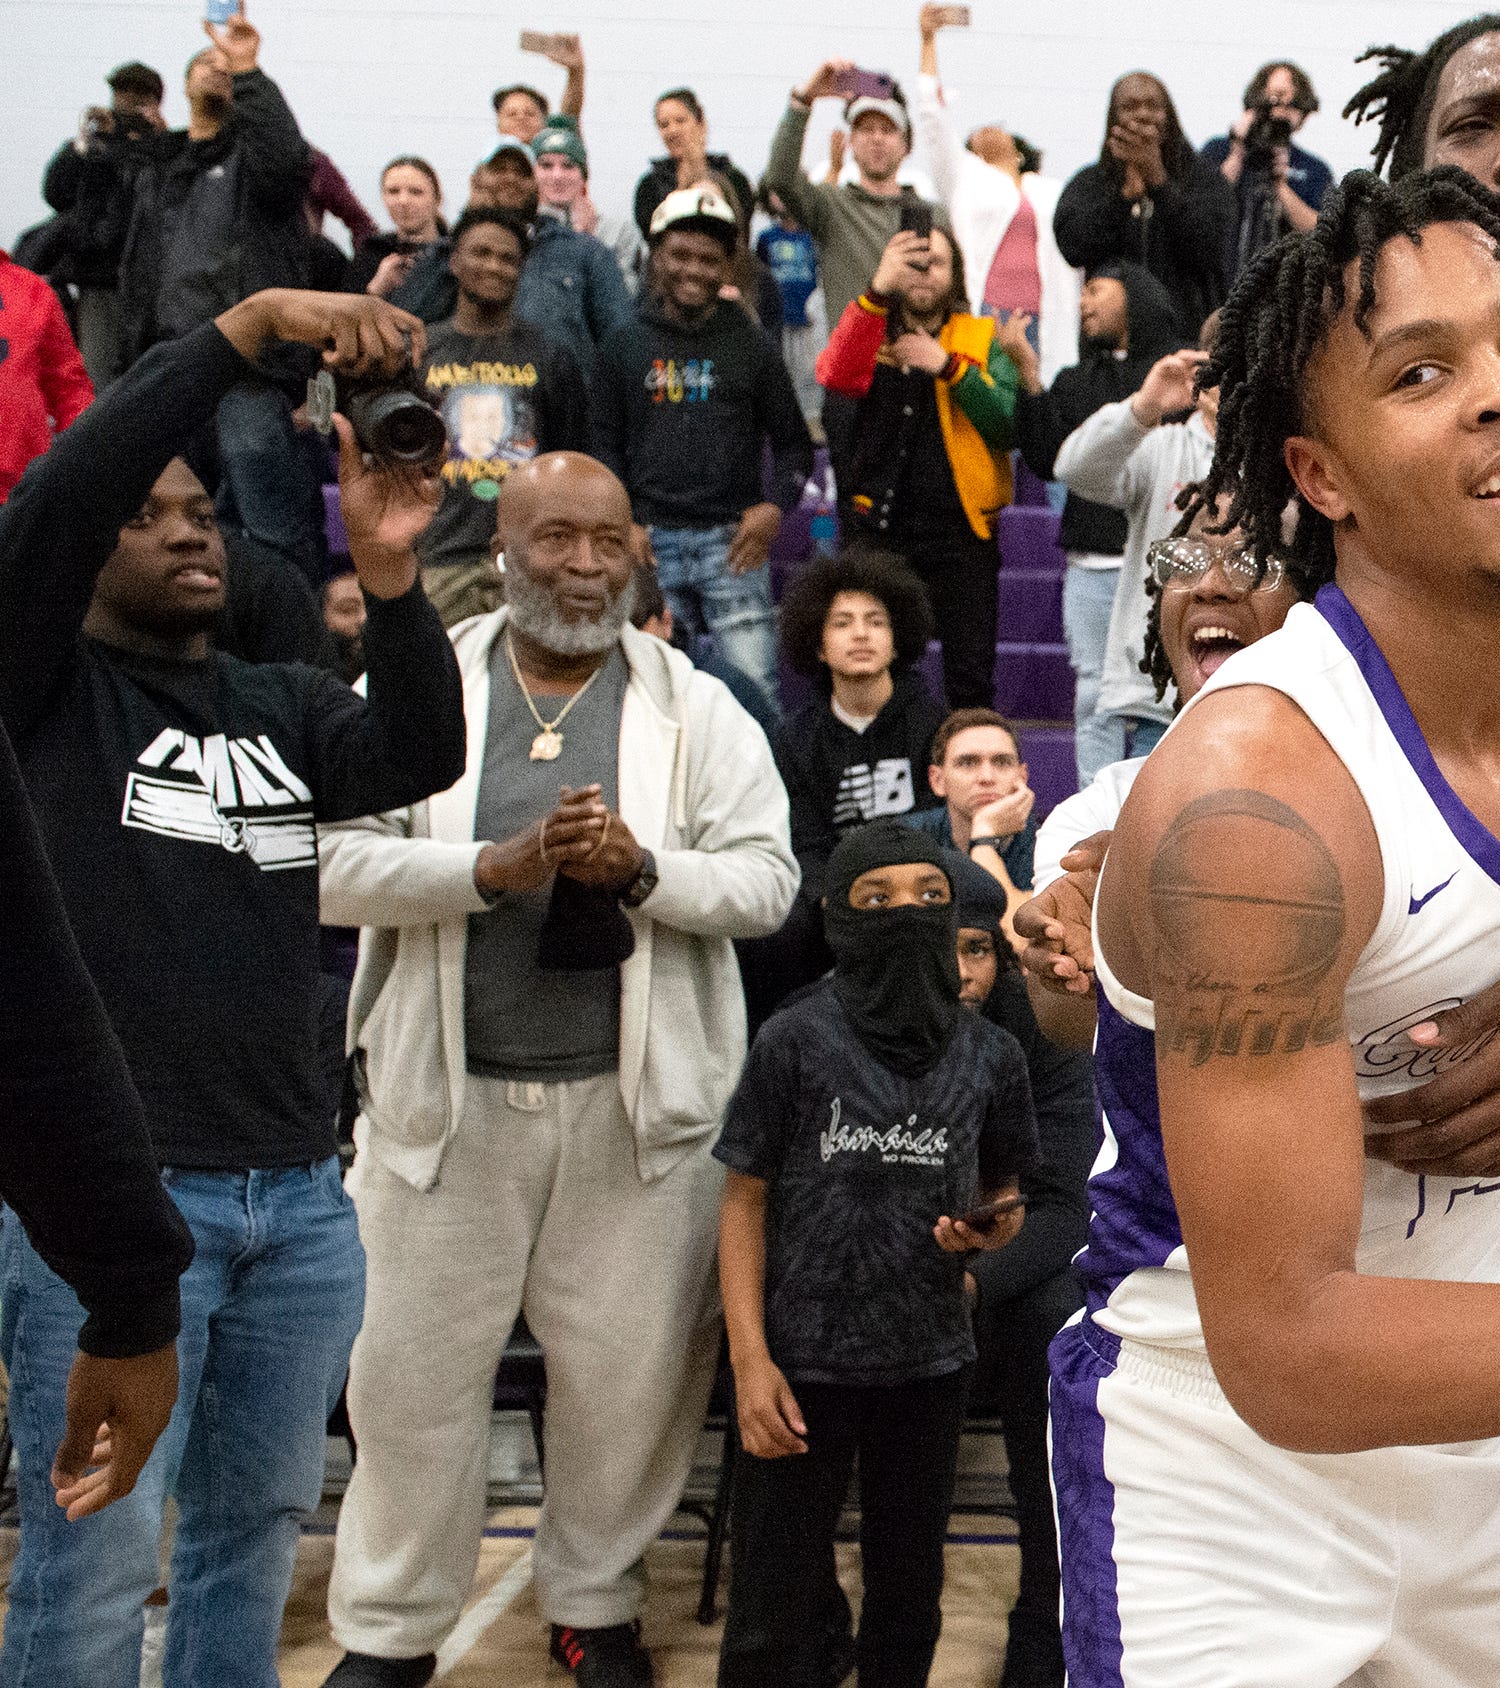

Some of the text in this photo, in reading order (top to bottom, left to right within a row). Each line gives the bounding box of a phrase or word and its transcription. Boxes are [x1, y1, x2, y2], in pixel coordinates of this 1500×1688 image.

[820, 1097, 949, 1162] Jamaica
[882, 1154, 945, 1166] NO PROBLEM
